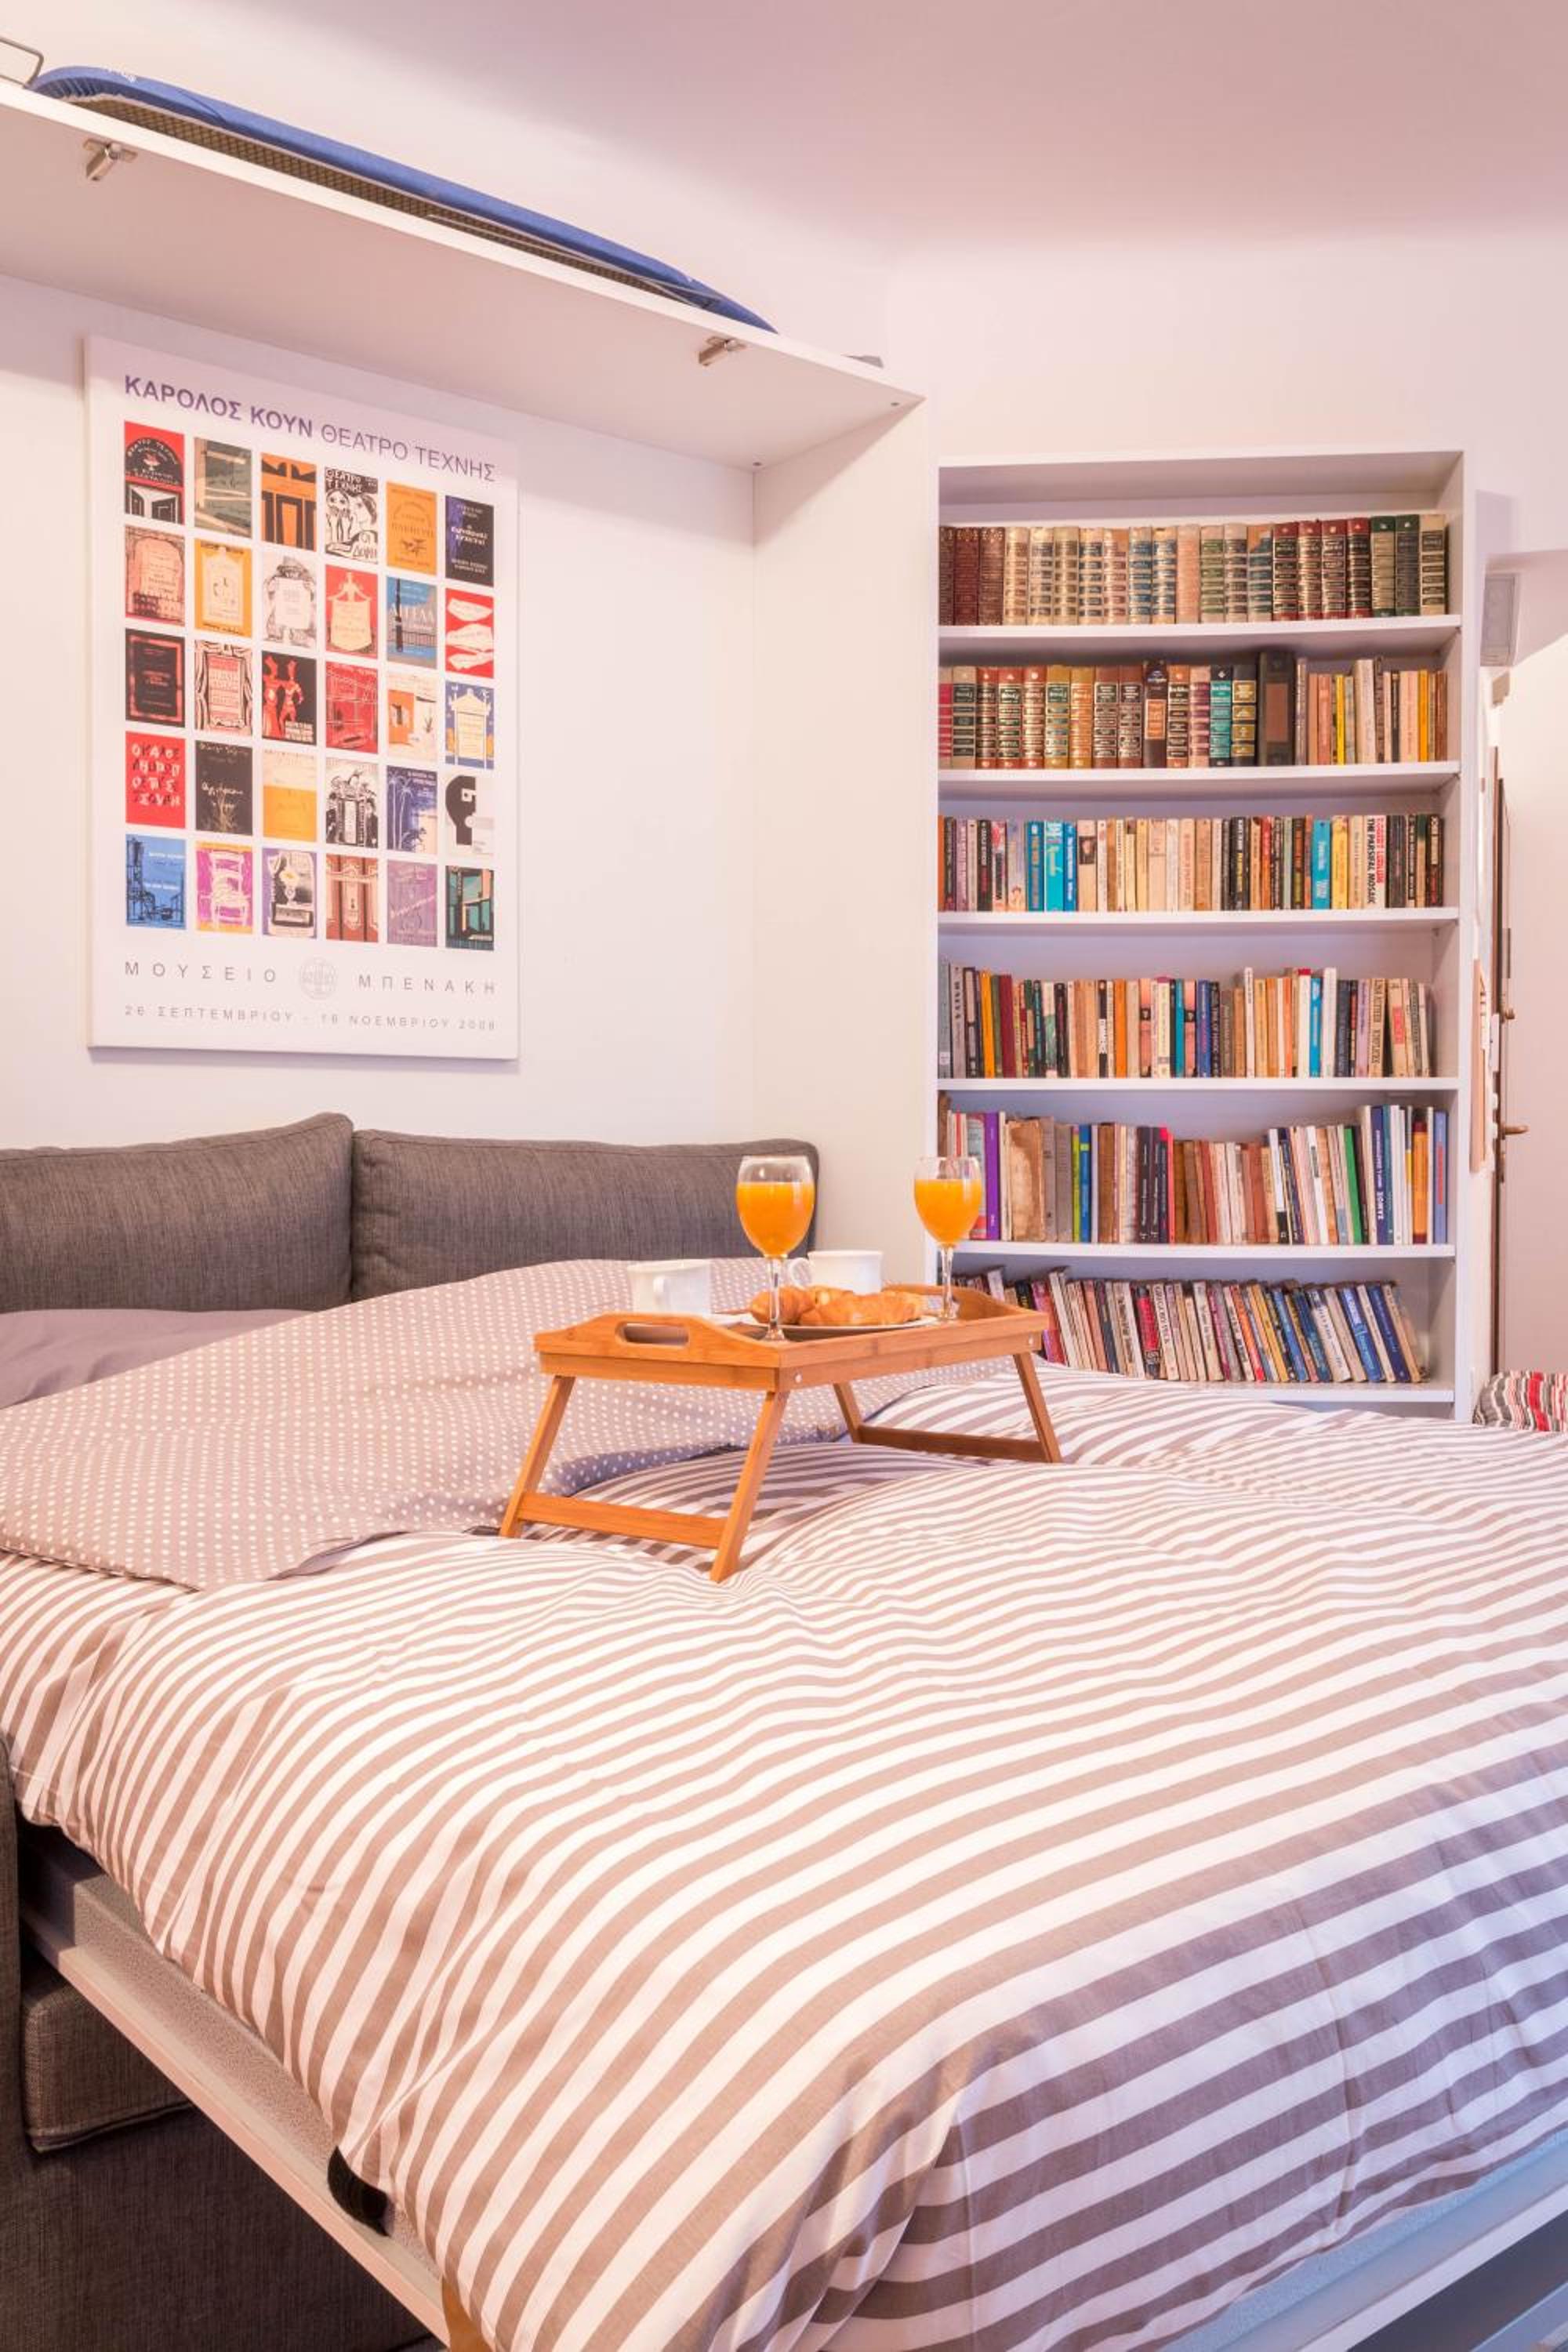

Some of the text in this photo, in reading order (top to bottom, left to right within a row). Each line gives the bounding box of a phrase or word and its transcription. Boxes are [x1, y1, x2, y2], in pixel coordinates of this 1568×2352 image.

[125, 375, 495, 482] ΚΑΡΟΛΟΣ ΚΟΥΝ ΘΕΑΤΡΟ ΤΕΧΝΗΣ
[1367, 833, 1376, 871] PARSIFAL
[1367, 873, 1376, 904] MOSAIC
[125, 960, 495, 995] ΜΟΥΣΕΙΟ ΜΠΕΝΑΚΗ
[158, 1006, 293, 1022] ΣΕΠΤΕΜΒΡΙΟΥ
[349, 1015, 449, 1029] ΝΟΕΜΒΡΙΟΥ
